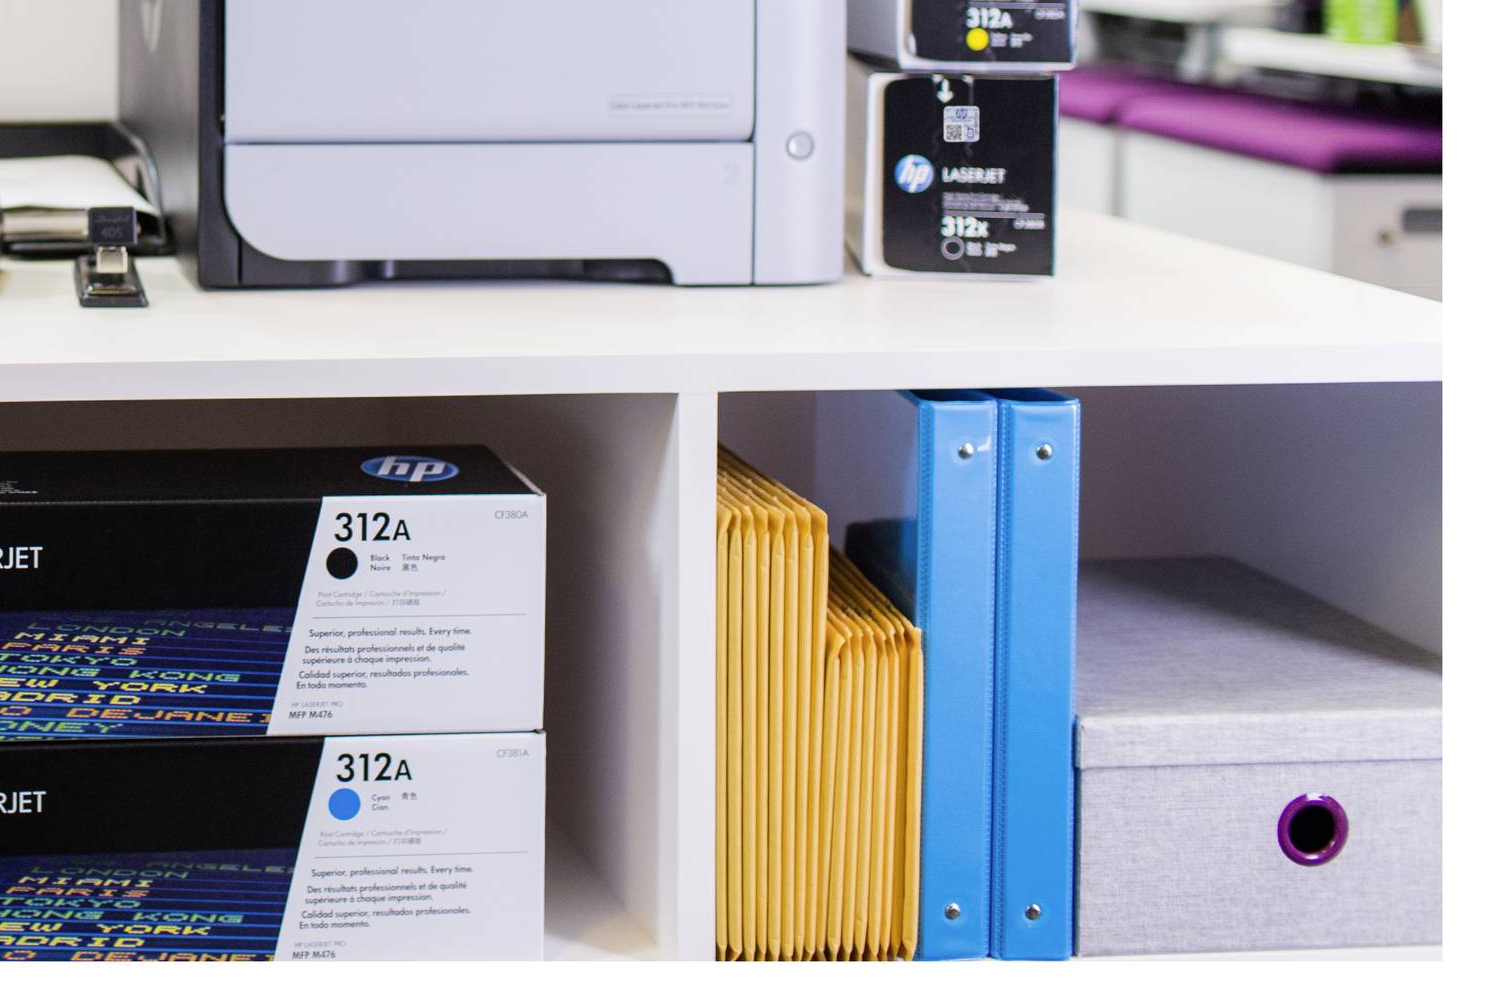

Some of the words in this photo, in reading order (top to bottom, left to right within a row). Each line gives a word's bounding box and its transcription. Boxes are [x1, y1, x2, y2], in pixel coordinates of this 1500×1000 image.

[965, 7, 1014, 29] 312A
[898, 155, 930, 194] hp
[941, 167, 1006, 184] LASERJET
[375, 455, 447, 482] hp
[494, 510, 529, 520] CF380A
[334, 512, 411, 542] 312A
[370, 553, 390, 562] Black
[370, 564, 391, 572] Noire
[27, 622, 186, 637] LONDON
[309, 628, 346, 639] Superior,
[348, 628, 396, 639] professional
[400, 627, 427, 636] results.
[429, 627, 451, 637] Every
[453, 626, 471, 635] time.
[14, 631, 150, 646] MIAMI
[2, 641, 147, 656] PARIS
[305, 645, 320, 654] Des
[321, 645, 355, 654] résultats
[357, 643, 415, 655] professionnels
[417, 644, 425, 652] et
[426, 643, 436, 652] de
[438, 643, 466, 654] qualité
[302, 656, 346, 666] supérieure
[354, 655, 384, 666] chaque
[386, 655, 432, 665] impression.
[129, 669, 242, 683] KONG
[299, 670, 331, 679] Calidad
[332, 670, 369, 680] superior,
[370, 668, 412, 678] resultados
[414, 667, 470, 679] profesionales.
[92, 680, 208, 695] YORK
[296, 681, 306, 690] En
[308, 681, 327, 689] todo
[328, 681, 368, 689] momento.
[289, 710, 307, 719] MFP
[309, 709, 333, 719] M476
[496, 748, 530, 758] CF381A
[336, 752, 412, 782] 312A
[372, 794, 390, 802] Cyan
[147, 861, 294, 873] ANGELE
[311, 868, 348, 879] Superior,
[350, 867, 399, 878] professional
[430, 865, 452, 875] Every
[19, 876, 154, 888] MIAMI
[307, 885, 322, 893] Des
[360, 882, 417, 893] professionnels
[428, 882, 438, 890] de
[6, 886, 150, 898] PARIS
[356, 894, 386, 904] chaque
[132, 911, 245, 924] KONG
[301, 910, 333, 919] Calidad
[372, 907, 414, 917] resultados
[415, 906, 471, 917] profesionales.
[97, 923, 211, 936] YORK
[299, 921, 309, 929] En
[292, 951, 310, 959] MFP
[312, 950, 336, 959] M476
